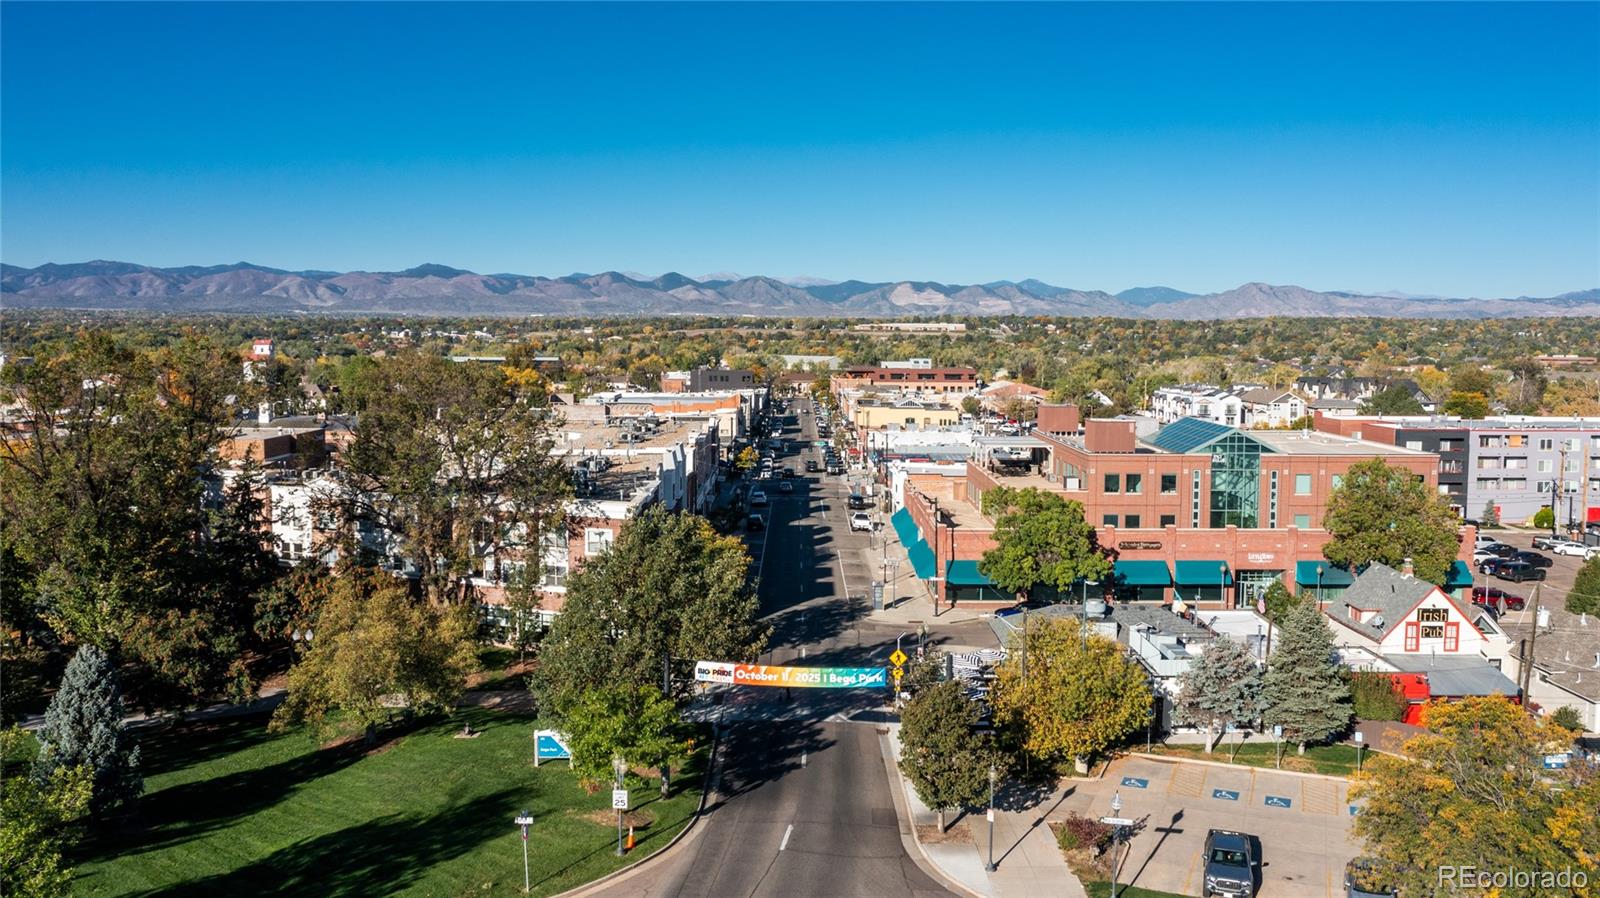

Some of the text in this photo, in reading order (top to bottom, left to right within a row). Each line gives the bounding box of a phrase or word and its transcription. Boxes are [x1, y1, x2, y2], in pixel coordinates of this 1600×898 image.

[1419, 609, 1447, 621] Irish
[1422, 626, 1443, 637] Pub
[712, 669, 732, 677] PRIDE
[736, 670, 778, 681] October
[796, 672, 821, 683] 2025
[829, 673, 856, 684] Bega
[859, 673, 883, 683] Park
[615, 799, 626, 807] 25
